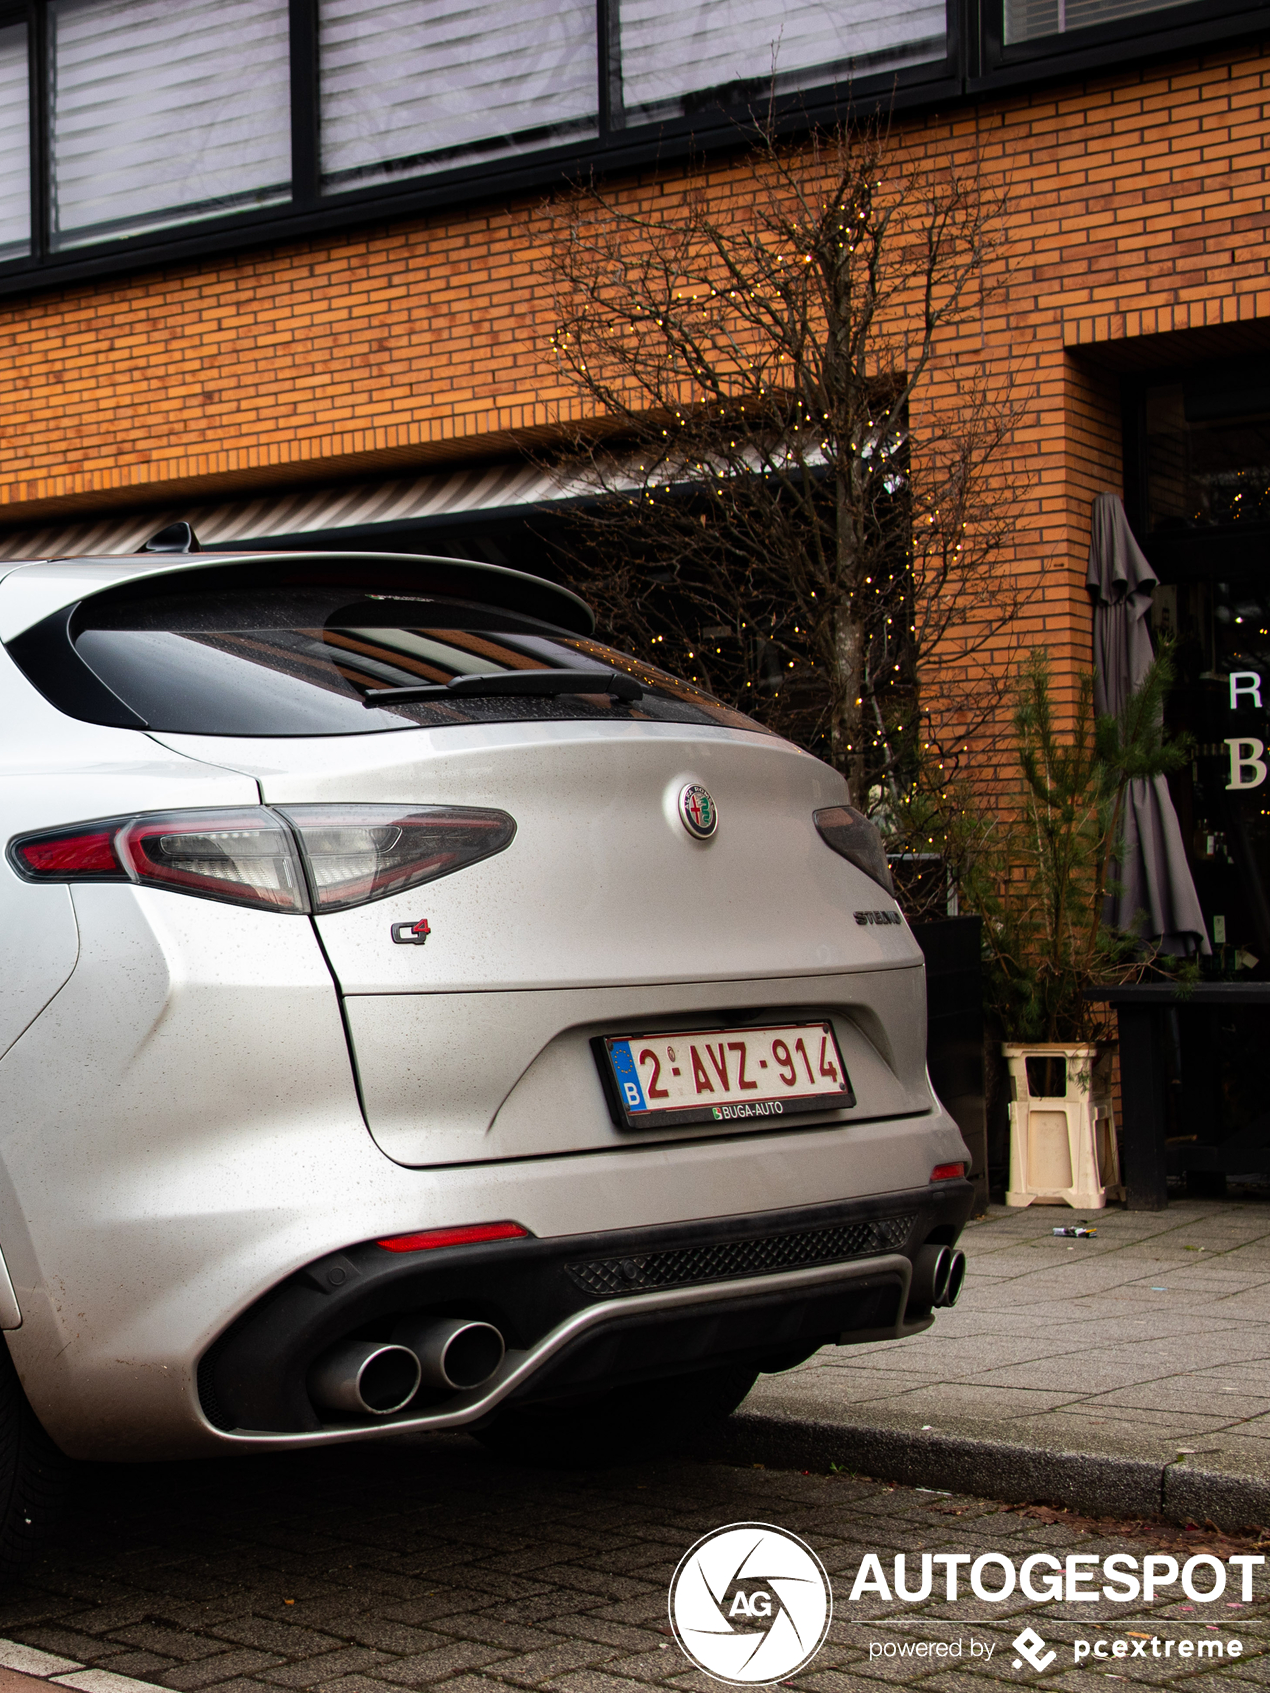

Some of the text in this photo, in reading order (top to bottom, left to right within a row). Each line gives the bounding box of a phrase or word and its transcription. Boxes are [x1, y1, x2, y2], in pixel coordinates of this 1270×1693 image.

[1229, 671, 1263, 709] R
[1223, 737, 1268, 791] B
[391, 918, 431, 946] Q4
[639, 1036, 838, 1100] 2-AVZ-914
[623, 1082, 641, 1106] B
[722, 1101, 784, 1120] BUGA-AUTO
